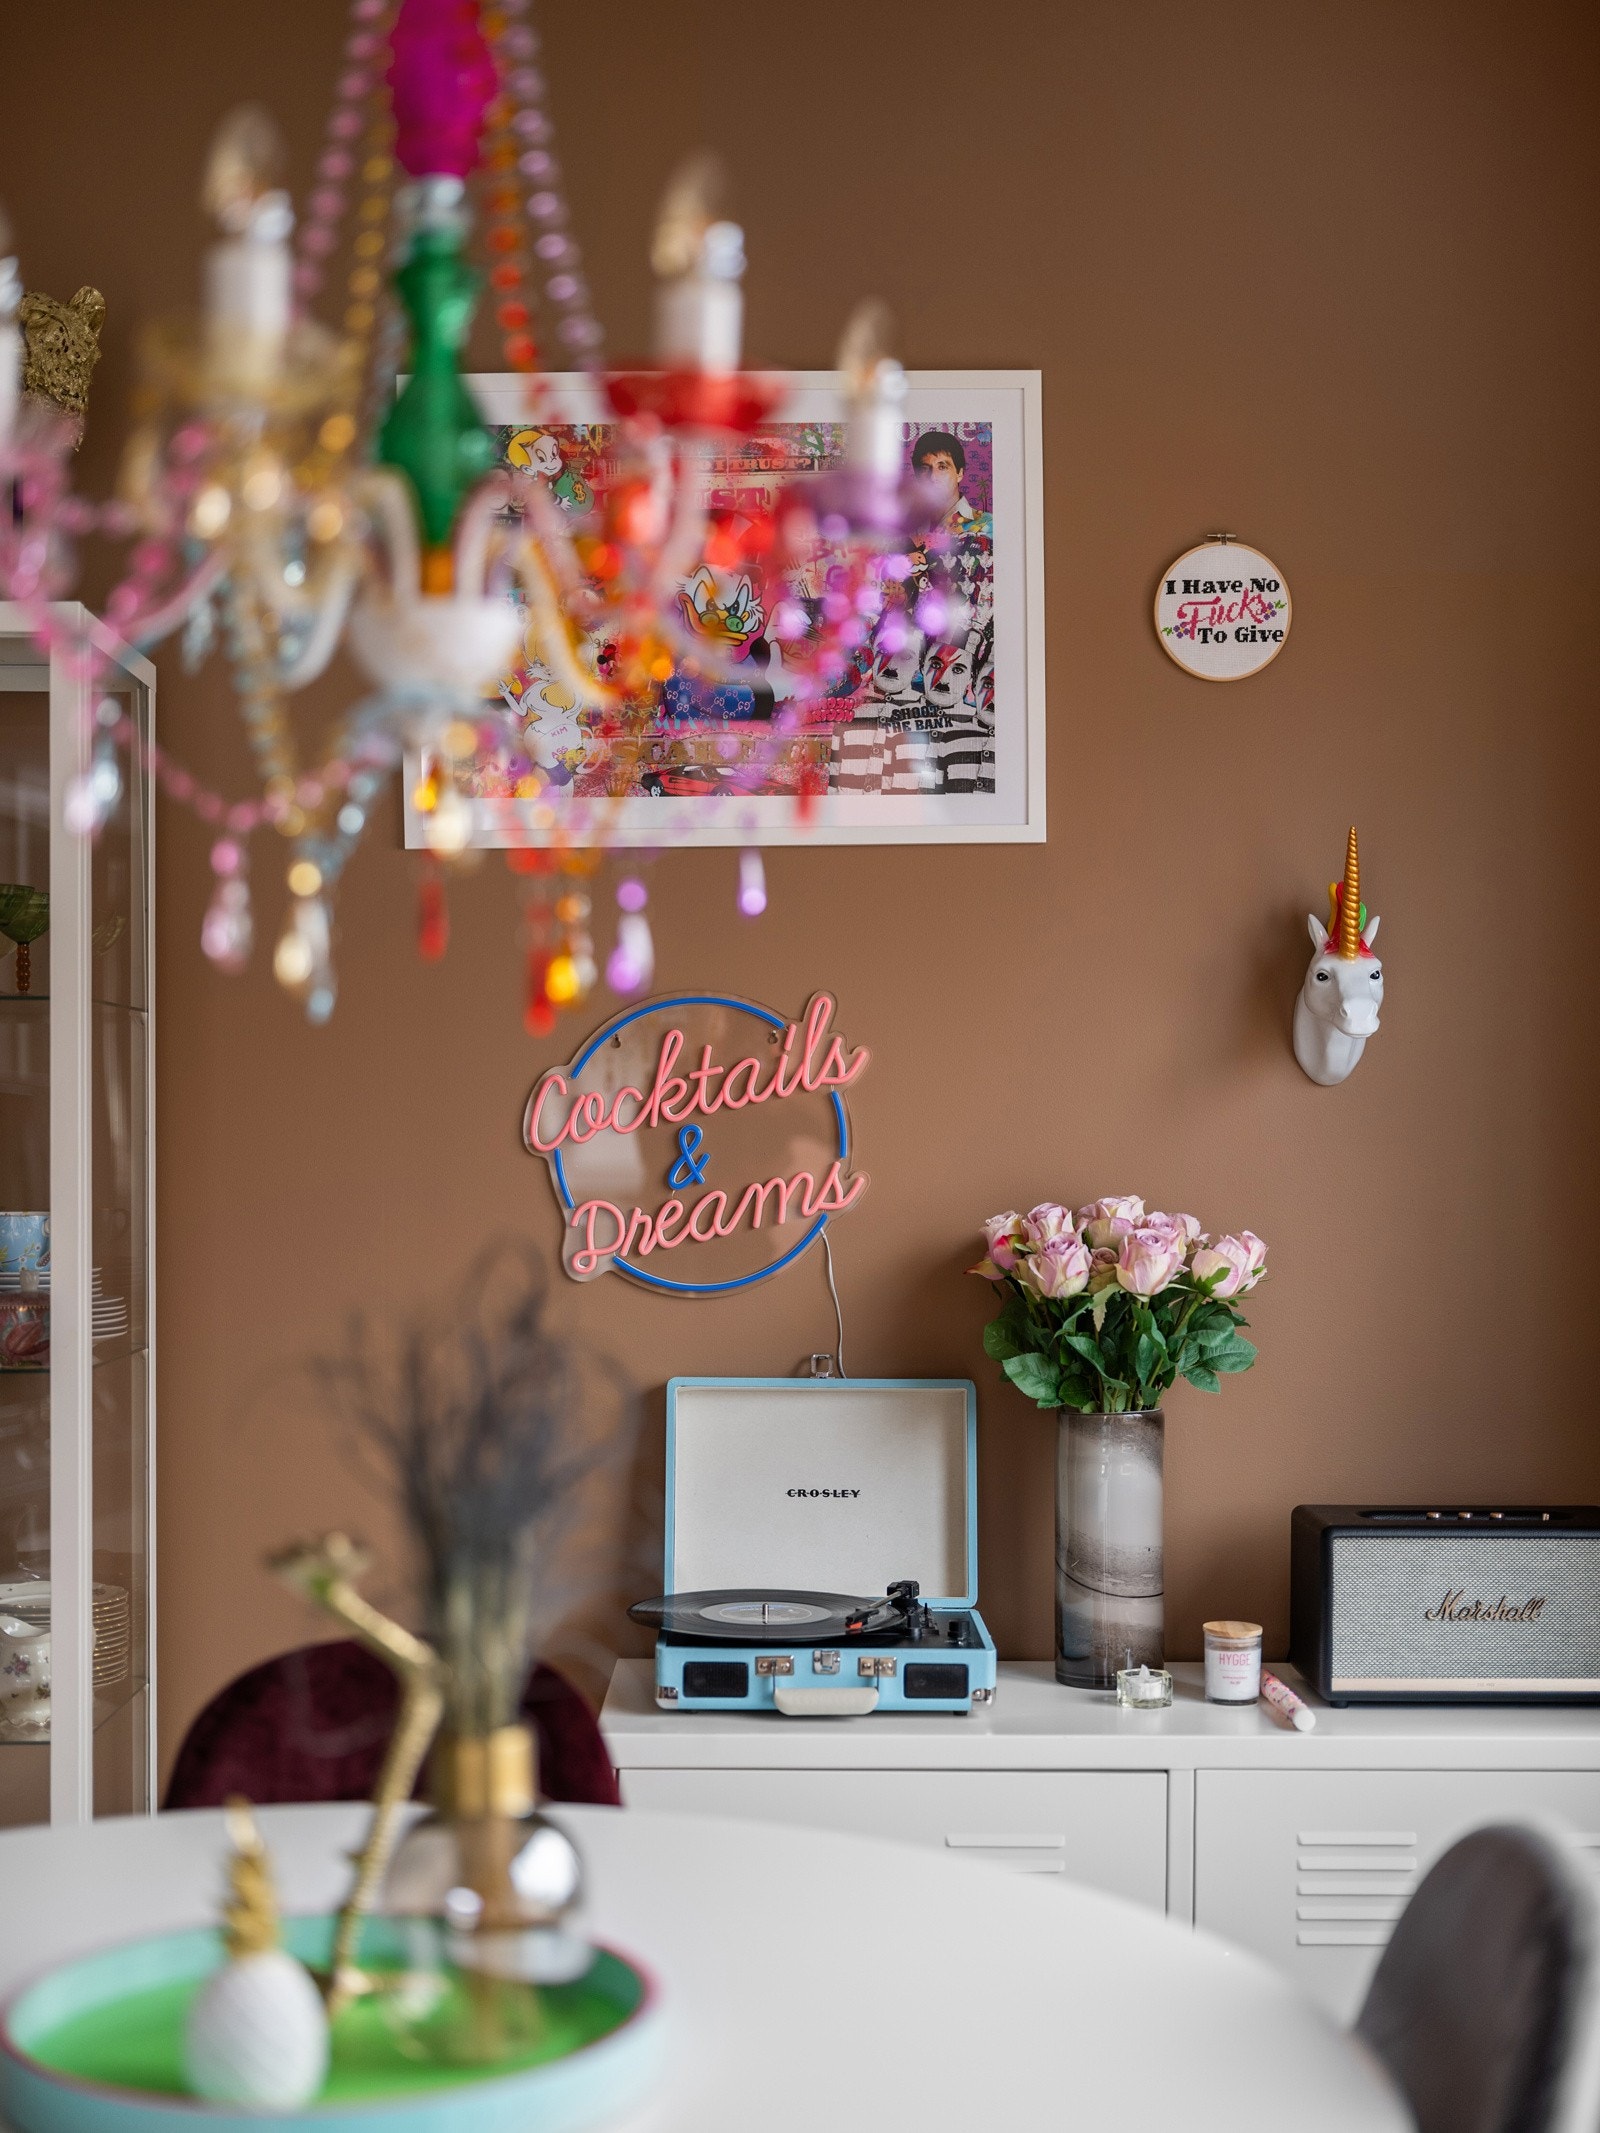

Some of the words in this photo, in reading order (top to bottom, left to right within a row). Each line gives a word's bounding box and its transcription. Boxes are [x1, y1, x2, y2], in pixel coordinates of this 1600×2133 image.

[1165, 580, 1177, 595] I
[1182, 579, 1243, 594] Have
[1249, 578, 1280, 593] No
[1197, 627, 1228, 644] To
[1234, 625, 1284, 643] Give
[551, 726, 568, 737] KIM
[883, 721, 912, 733] THE
[914, 716, 954, 731] BANK
[551, 745, 569, 759] ASS
[530, 996, 867, 1152] Cocktails
[668, 1124, 711, 1191] &
[571, 1161, 865, 1274] Dreams
[786, 1488, 862, 1498] CROSLEY
[1425, 1588, 1547, 1622] Marshall
[1218, 1653, 1252, 1666] HYGGE
